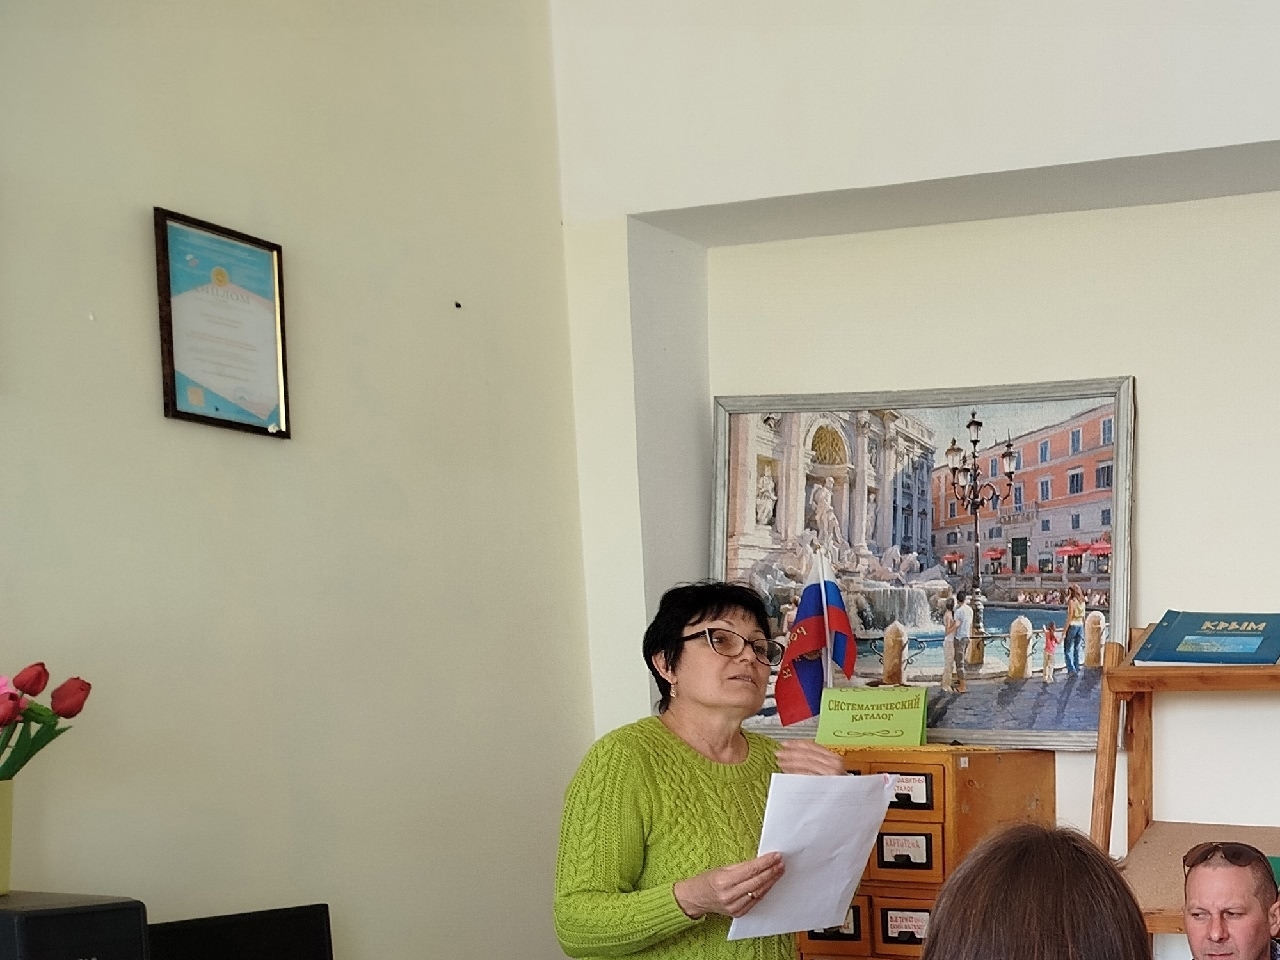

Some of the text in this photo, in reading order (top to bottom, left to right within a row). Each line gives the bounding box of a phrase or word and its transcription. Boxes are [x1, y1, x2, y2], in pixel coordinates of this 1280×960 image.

[1200, 620, 1267, 632] КРЫМ
[828, 694, 920, 711] СИСТЕМАТИЧЕСКИЙ
[851, 713, 894, 723] КАТАЛОГ
